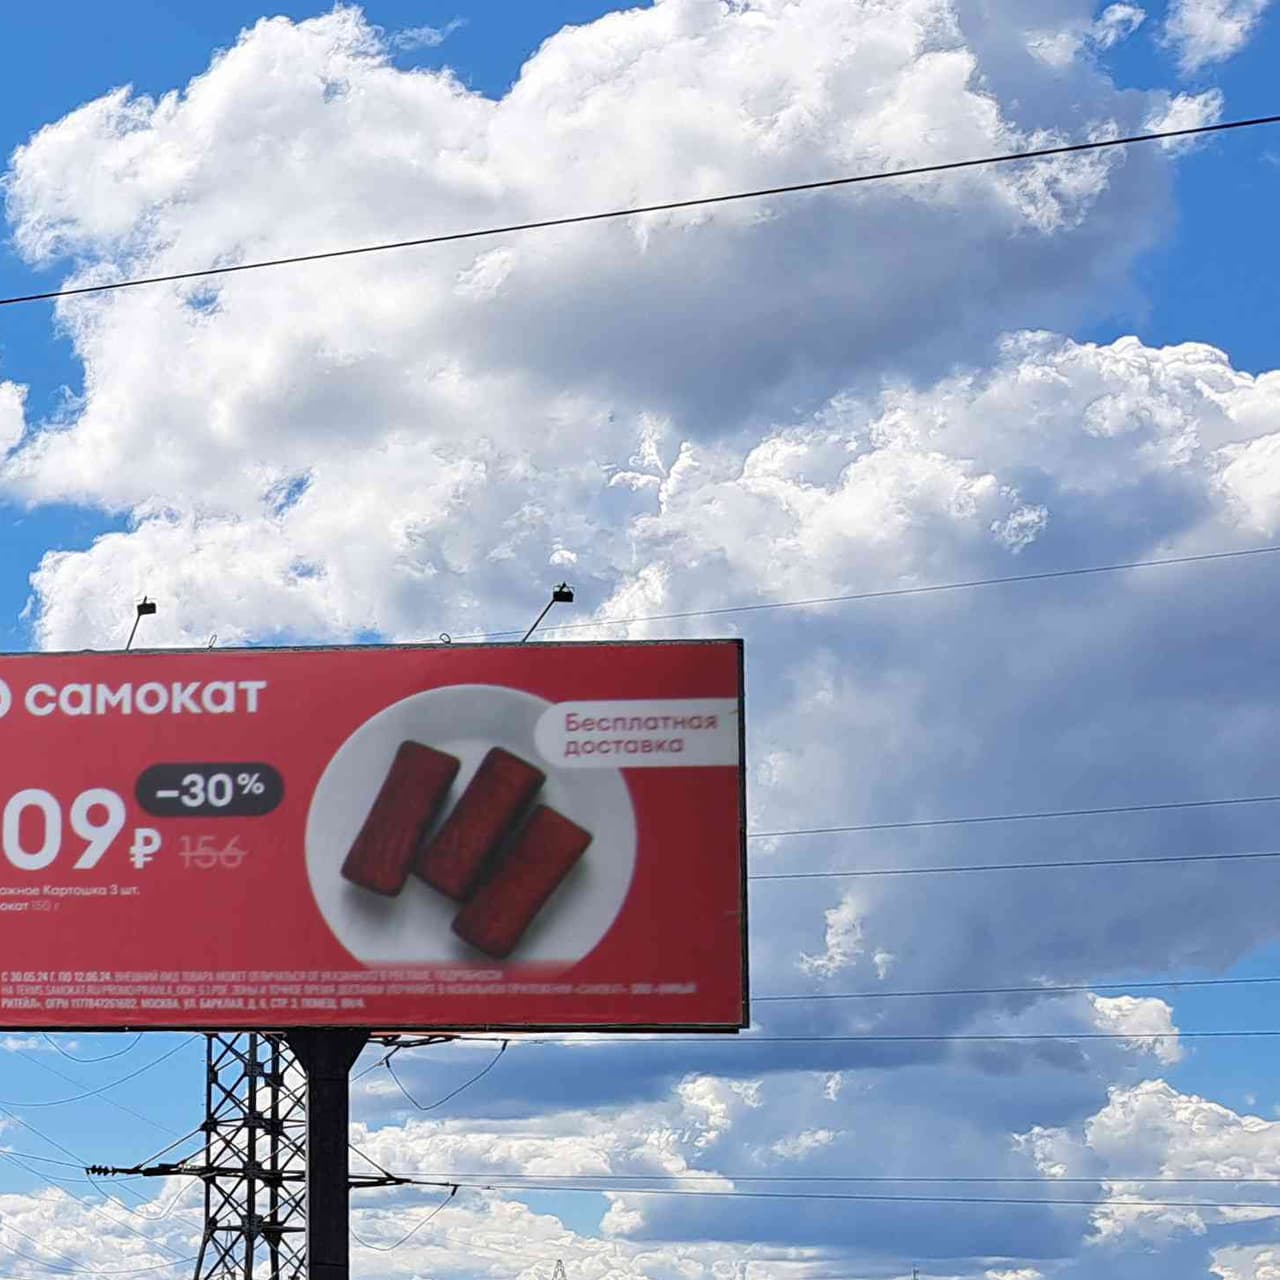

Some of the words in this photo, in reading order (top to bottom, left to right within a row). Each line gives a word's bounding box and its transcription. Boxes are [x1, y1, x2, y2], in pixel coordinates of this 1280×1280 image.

[24, 680, 267, 717] самокат
[564, 712, 719, 732] Бесплатная
[564, 737, 685, 757] доставка
[177, 834, 249, 869] 156
[42, 884, 108, 898] Картошка
[109, 884, 118, 896] 3
